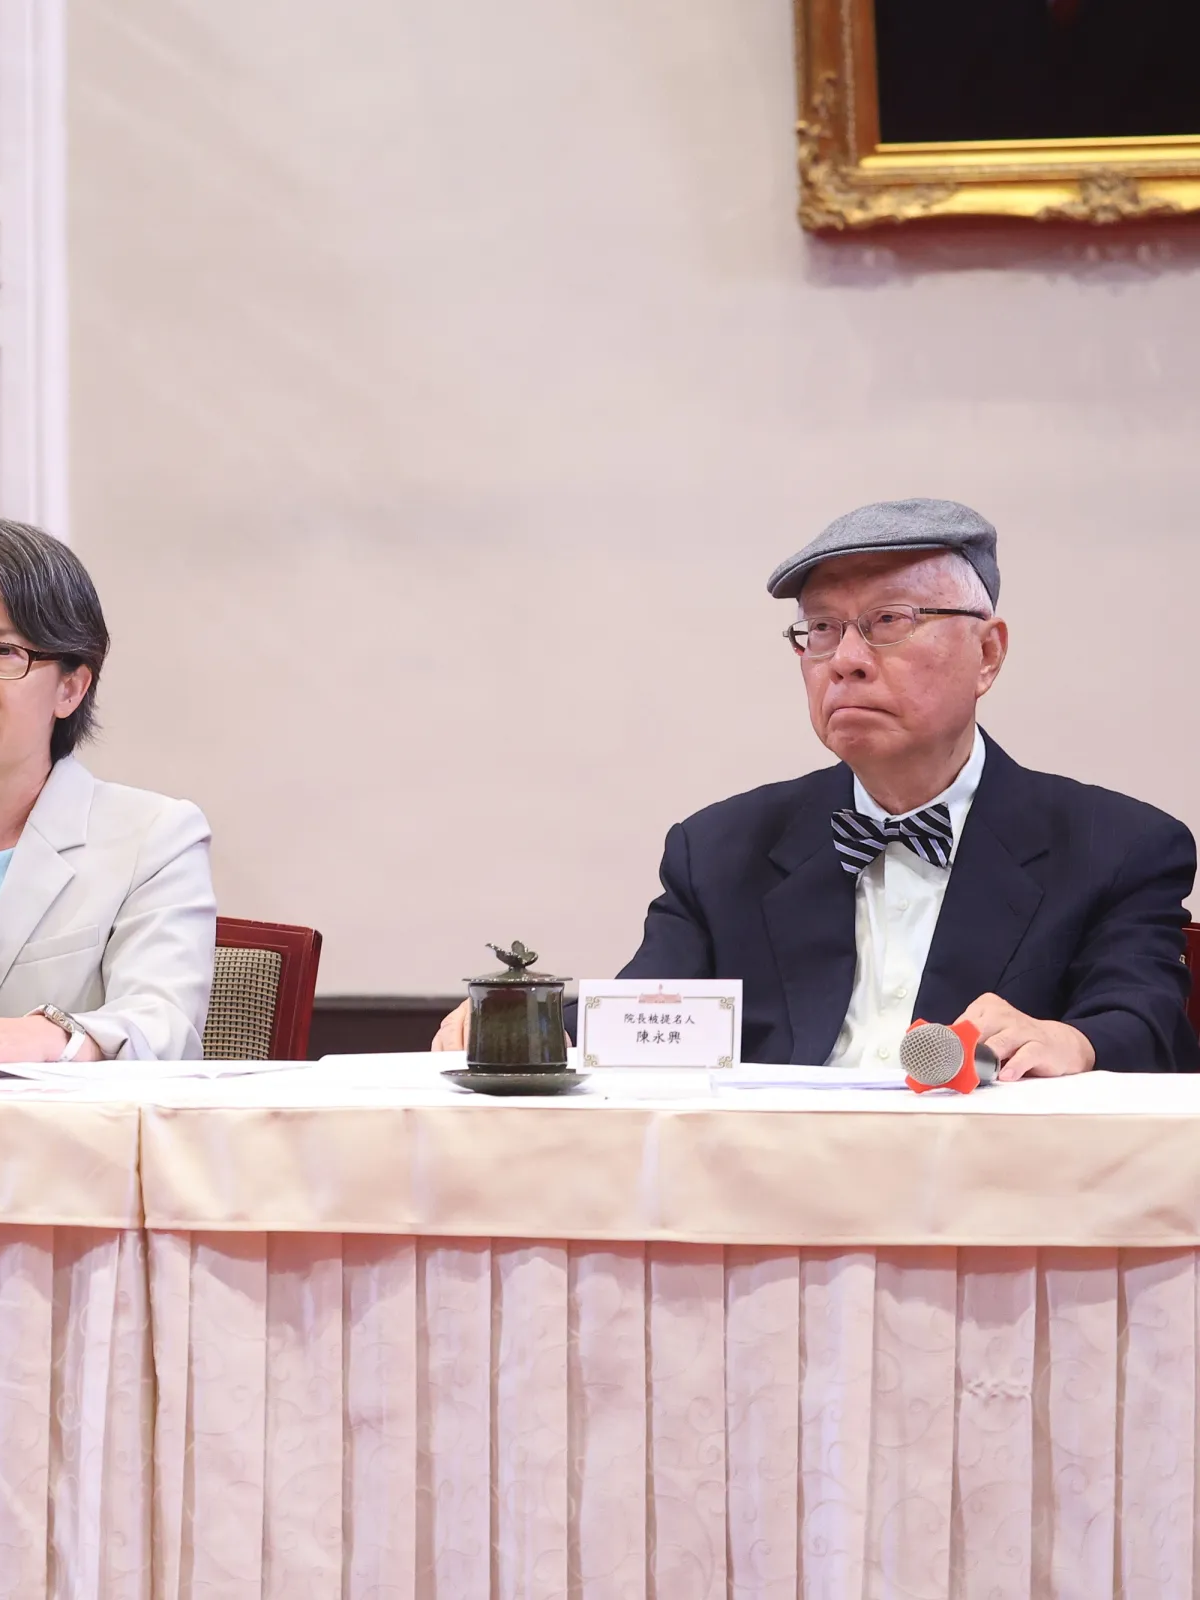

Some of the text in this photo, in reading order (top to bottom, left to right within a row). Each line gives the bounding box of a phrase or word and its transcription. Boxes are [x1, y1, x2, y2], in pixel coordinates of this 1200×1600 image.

[623, 1013, 696, 1025] 院長被提名人
[636, 1029, 682, 1044] 陳永興
